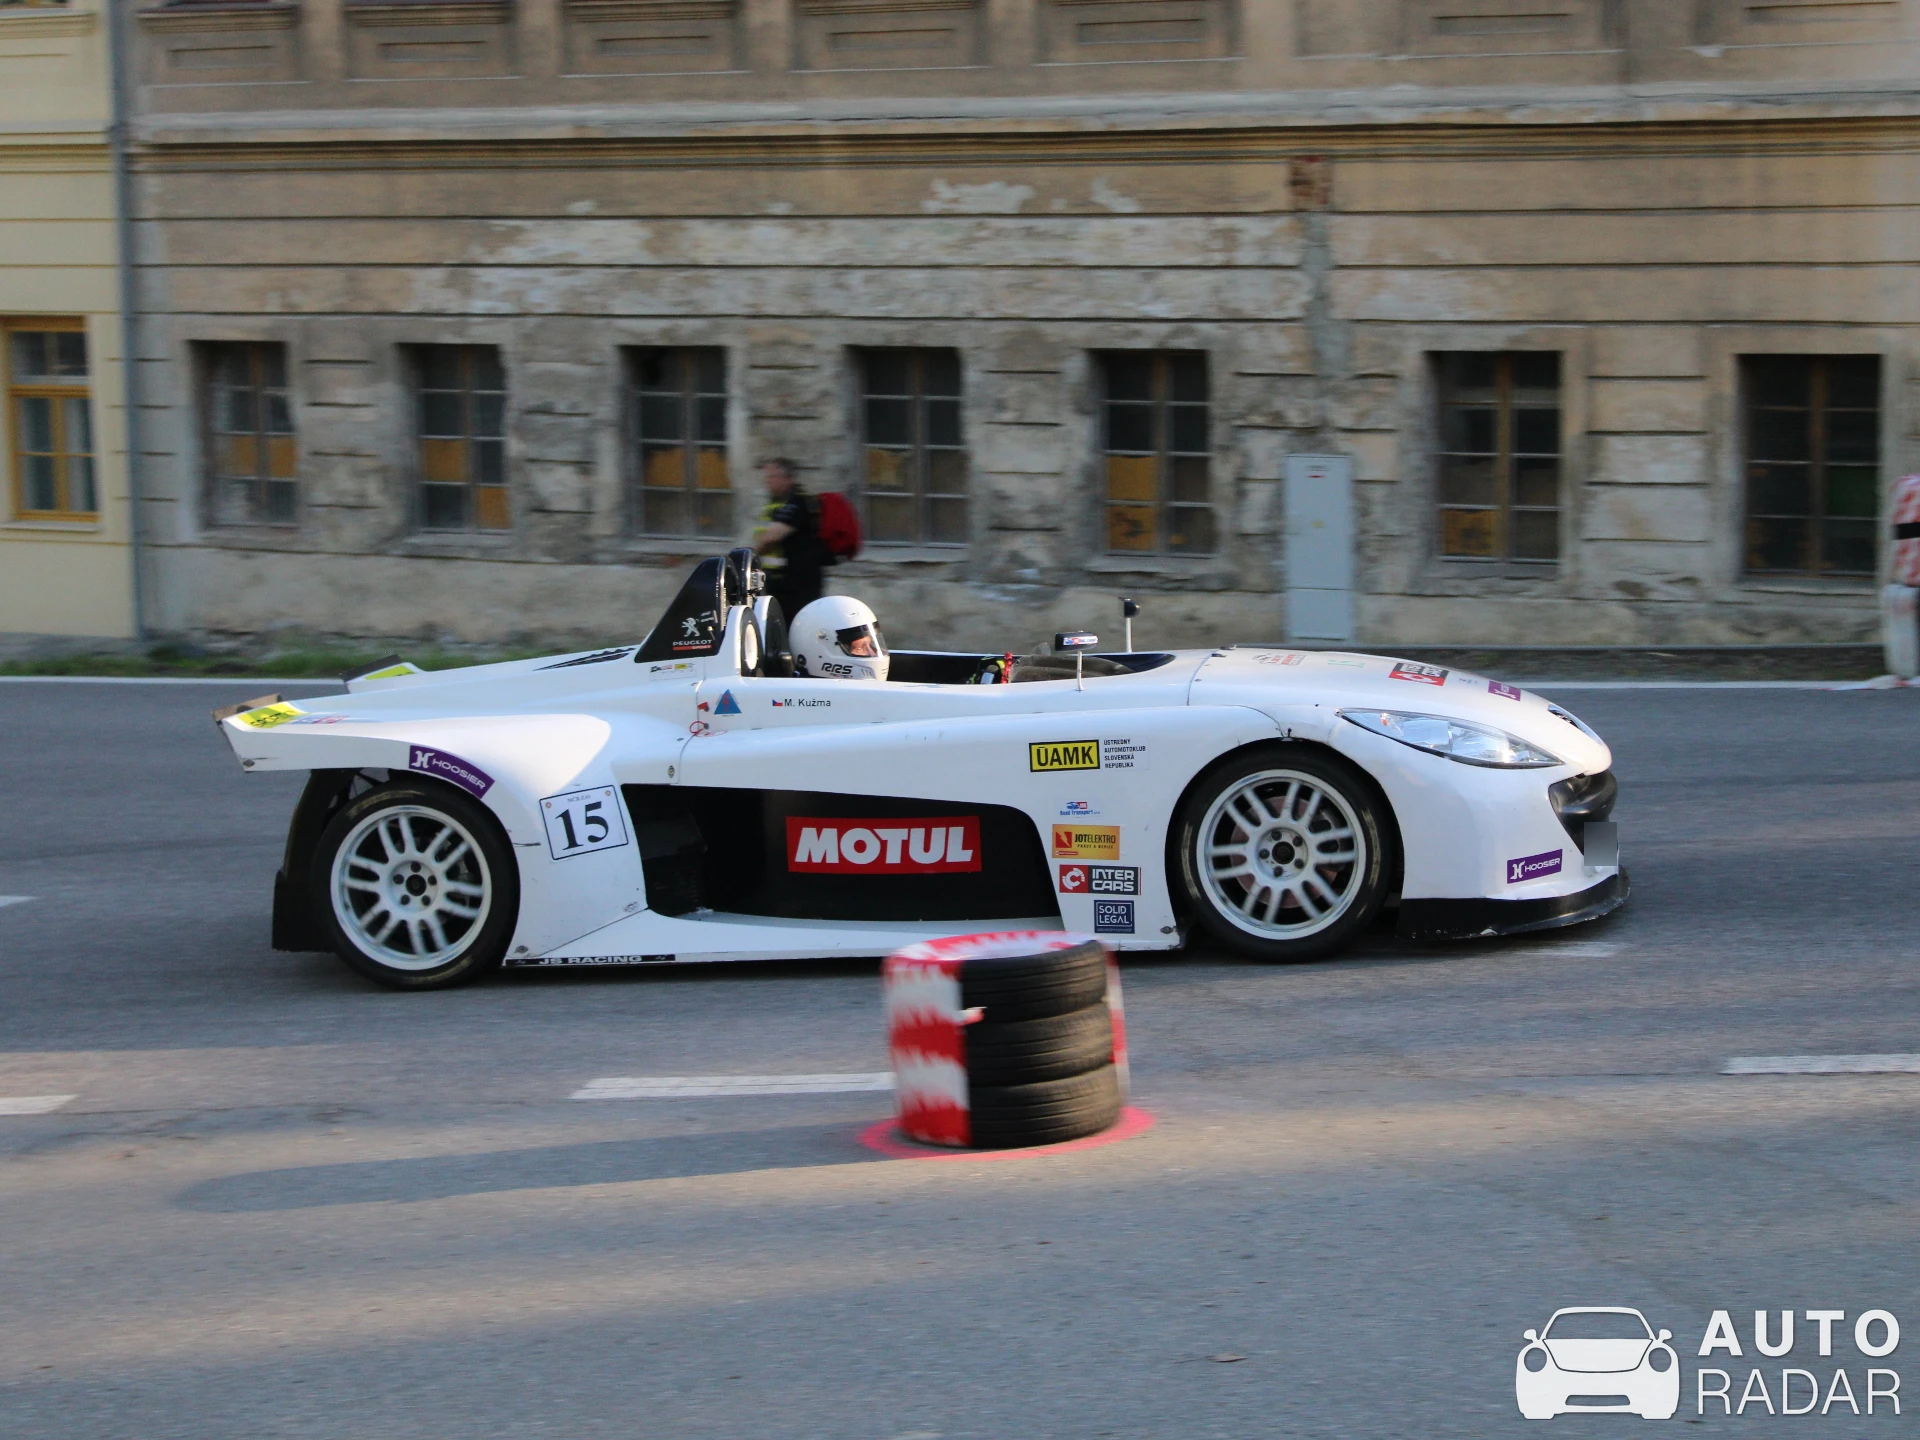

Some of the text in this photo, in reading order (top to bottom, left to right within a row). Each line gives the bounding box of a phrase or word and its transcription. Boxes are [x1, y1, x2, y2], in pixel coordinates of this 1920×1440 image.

[821, 662, 853, 675] RRS
[784, 698, 831, 707] M. Kužma
[1104, 745, 1146, 753] AUTOMOTOKLUB
[432, 758, 486, 789] HOOSIER
[555, 801, 609, 851] 15
[1074, 833, 1116, 844] JOTELEKTRO
[795, 827, 973, 864] MOTUL
[1524, 857, 1561, 872] HOOSIER
[1091, 868, 1135, 881] INTER
[1092, 880, 1135, 892] CARS
[1098, 905, 1127, 914] SOLID
[1099, 915, 1129, 924] LEGAL
[567, 955, 643, 964] RACING
